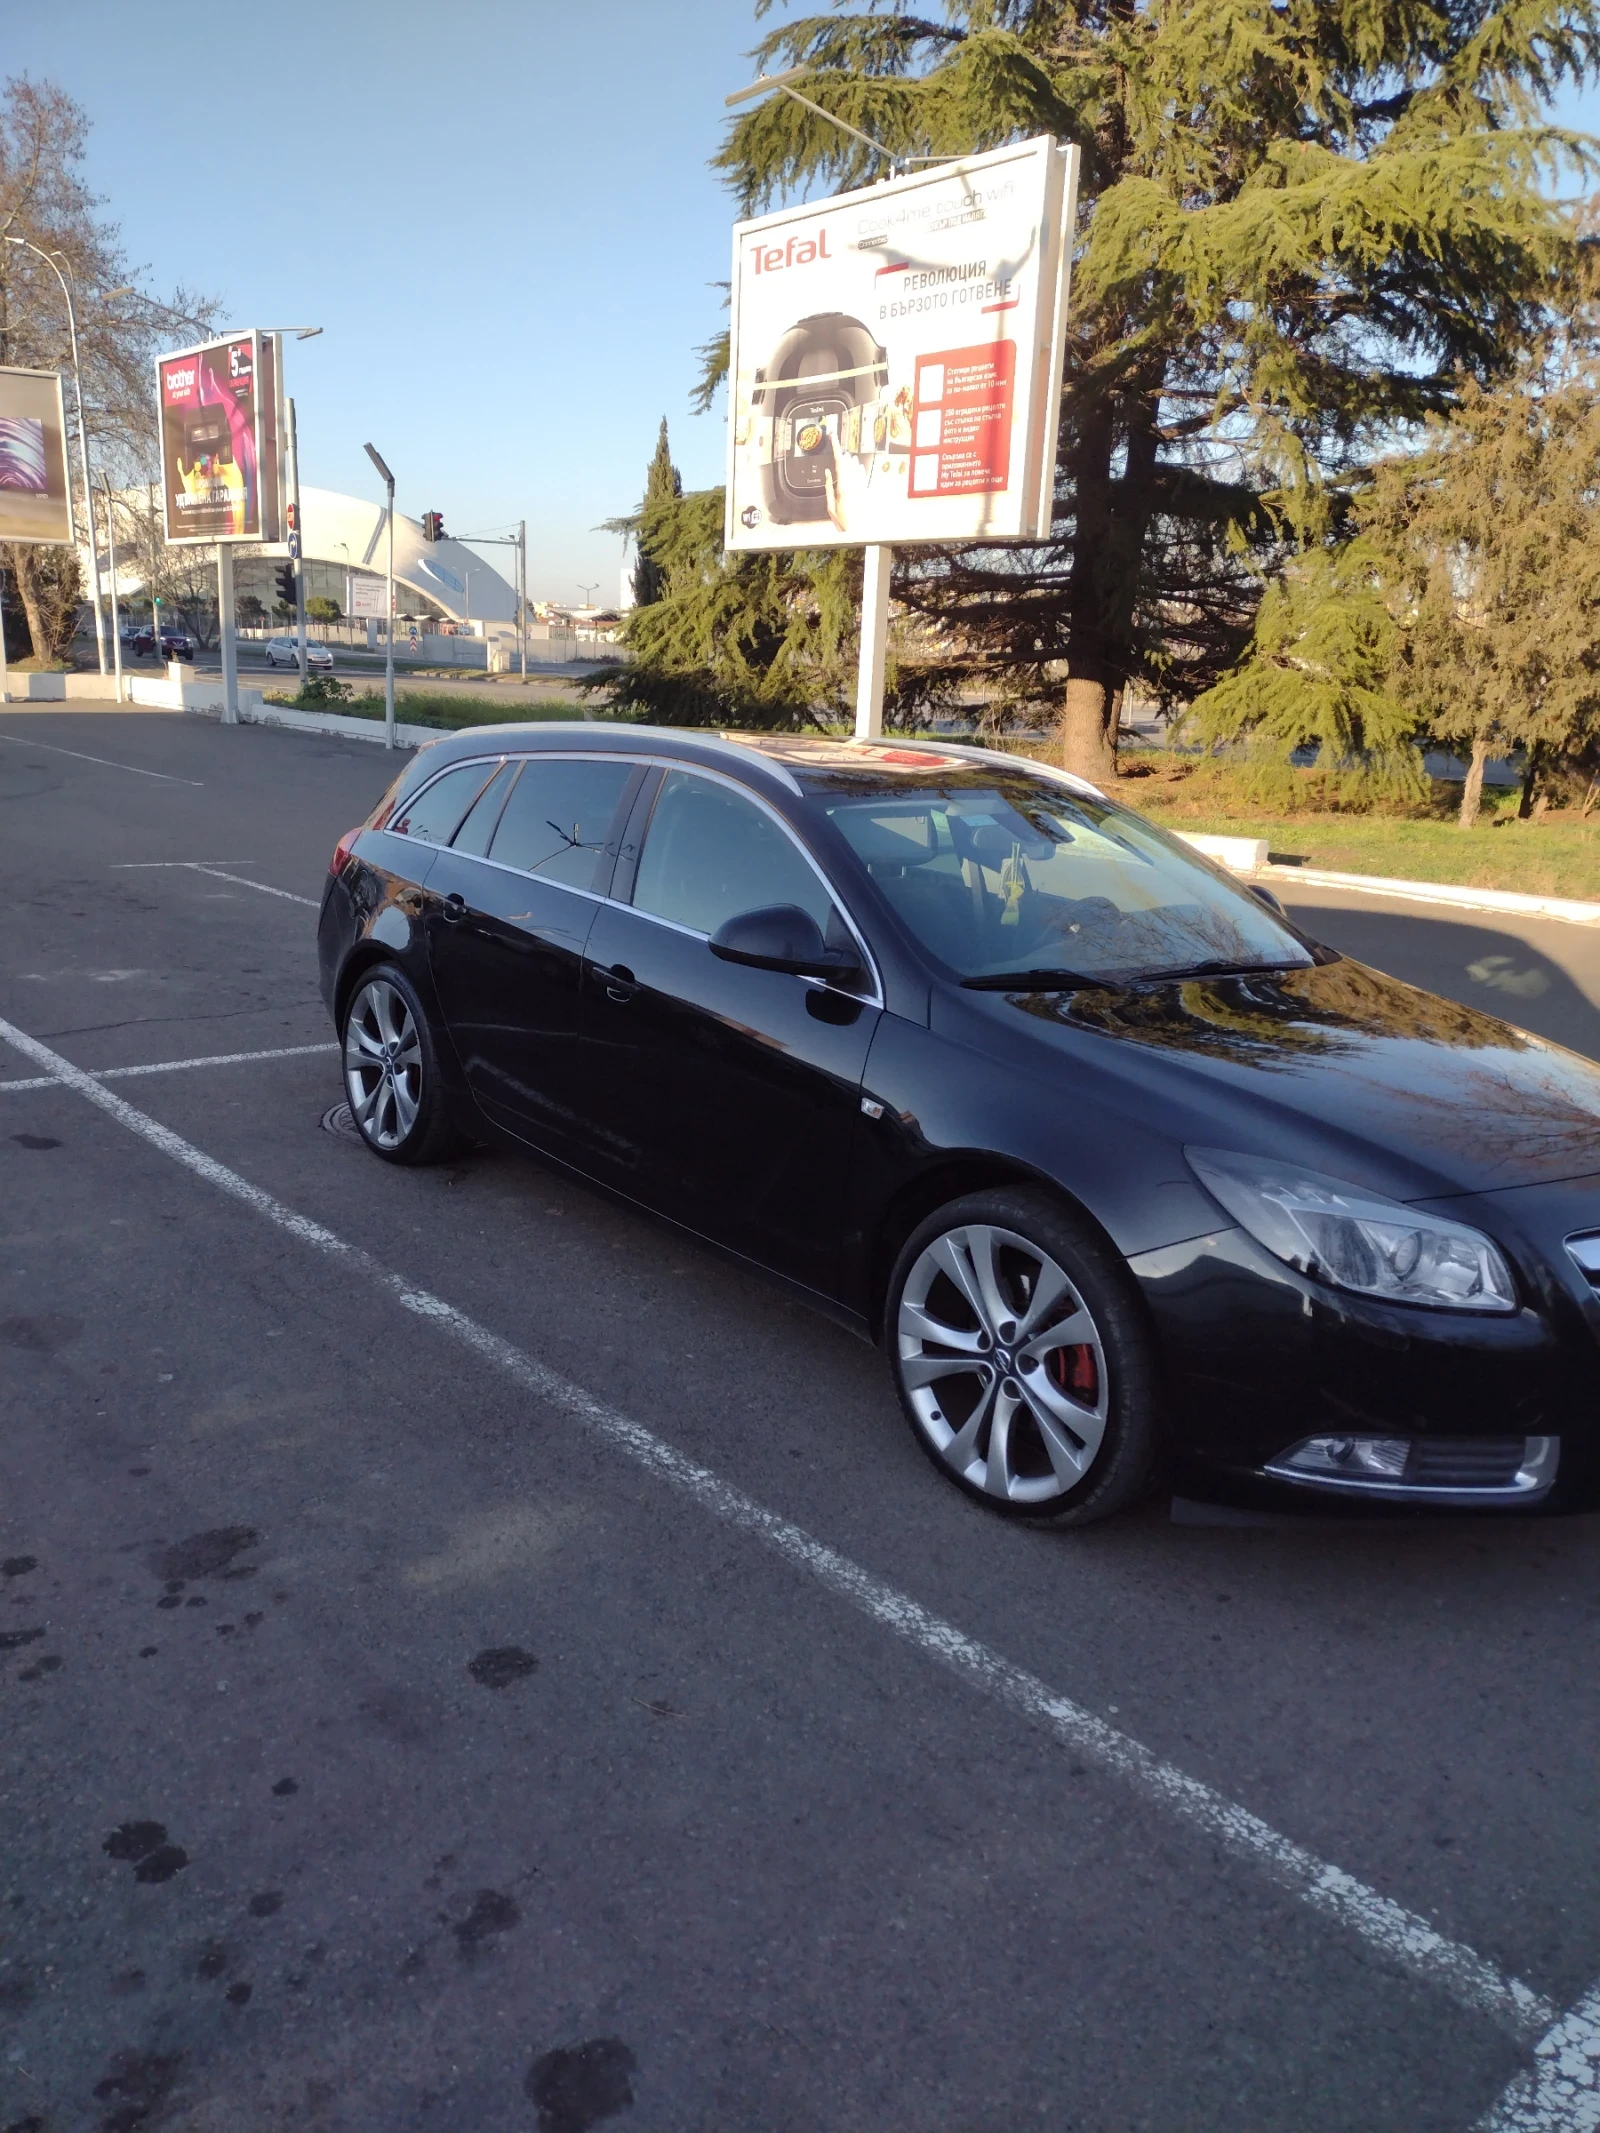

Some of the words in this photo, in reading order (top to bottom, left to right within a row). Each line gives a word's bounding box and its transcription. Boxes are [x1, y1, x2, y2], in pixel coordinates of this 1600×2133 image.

[858, 206, 931, 235] Cook4me
[937, 189, 982, 214] touch
[986, 179, 1015, 201] wifi
[750, 229, 832, 275] Tefal
[904, 260, 987, 292] РЕВОЛЮЦИЯ
[879, 305, 887, 320] В
[890, 292, 948, 318] БЪРЗОТО
[952, 278, 1012, 306] ГОТВЕНЕ
[166, 369, 195, 390] brother
[954, 374, 982, 384] български
[954, 383, 979, 393] по-малко
[988, 379, 994, 388] 10
[982, 402, 1006, 414] рецепти
[955, 416, 973, 425] стъпка
[941, 471, 949, 480] My
[950, 470, 962, 478] Tefal
[991, 476, 1004, 484] още
